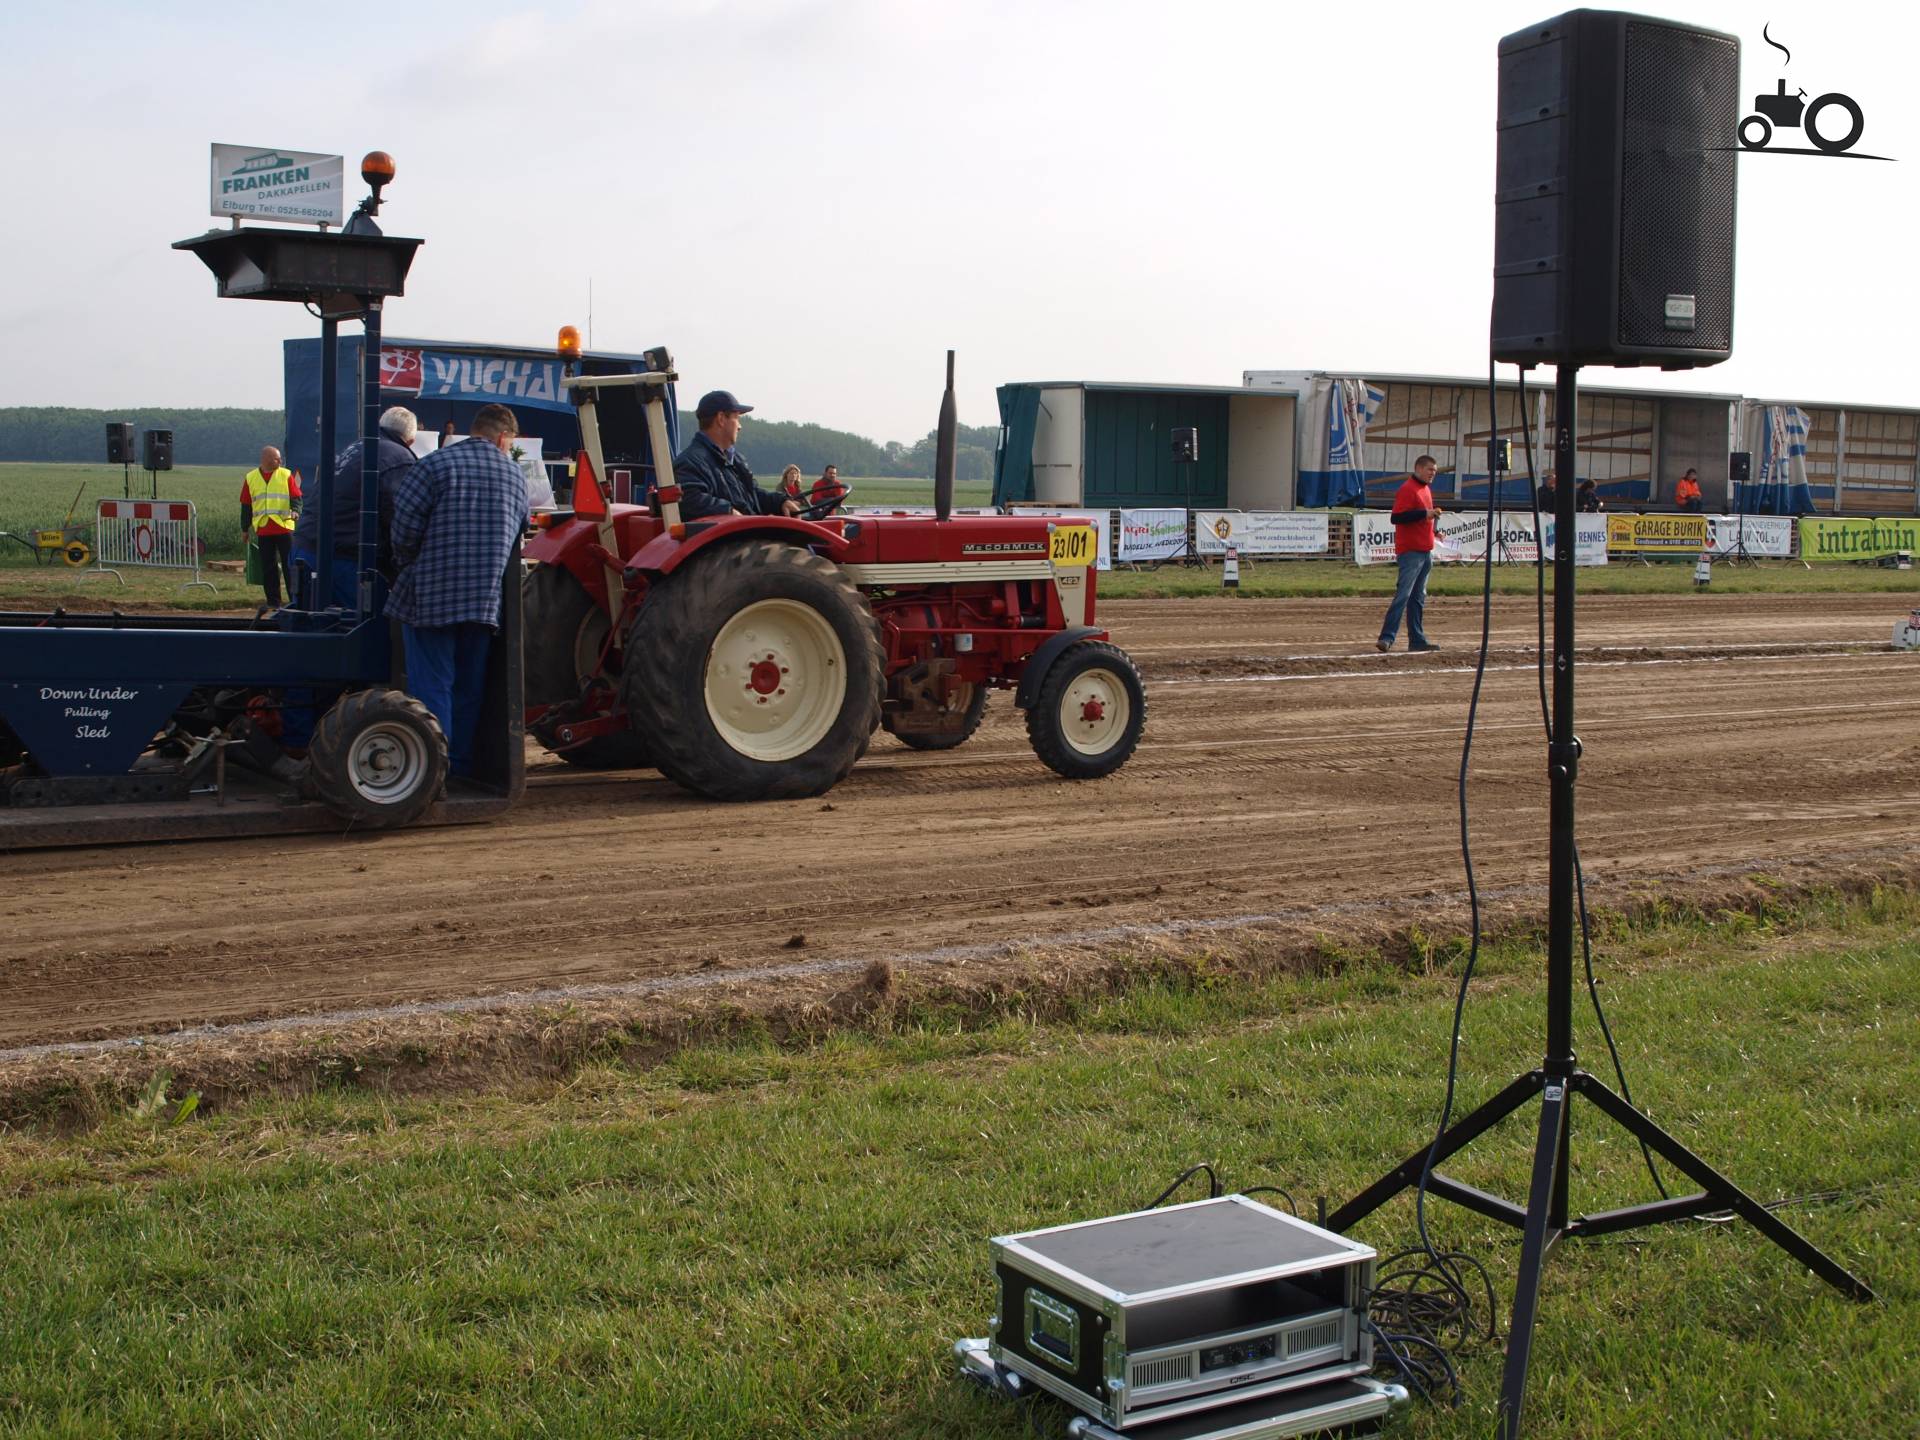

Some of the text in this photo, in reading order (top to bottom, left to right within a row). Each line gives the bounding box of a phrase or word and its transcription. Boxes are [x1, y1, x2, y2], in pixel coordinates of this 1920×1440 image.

[222, 166, 310, 194] FRANKEN
[258, 181, 331, 200] DAKKAPELLEN
[222, 200, 256, 213] Elburg
[259, 204, 275, 213] Tel:
[1634, 520, 1671, 536] GARAGE
[1674, 521, 1704, 537] BURIK
[1578, 531, 1606, 543] RENNES
[1817, 520, 1915, 553] intratuin
[964, 543, 1044, 551] McCORMICK
[1053, 531, 1088, 558] 23/01
[39, 687, 139, 700] Down Under
[64, 706, 111, 720] Pulling
[75, 725, 111, 738] Sled
